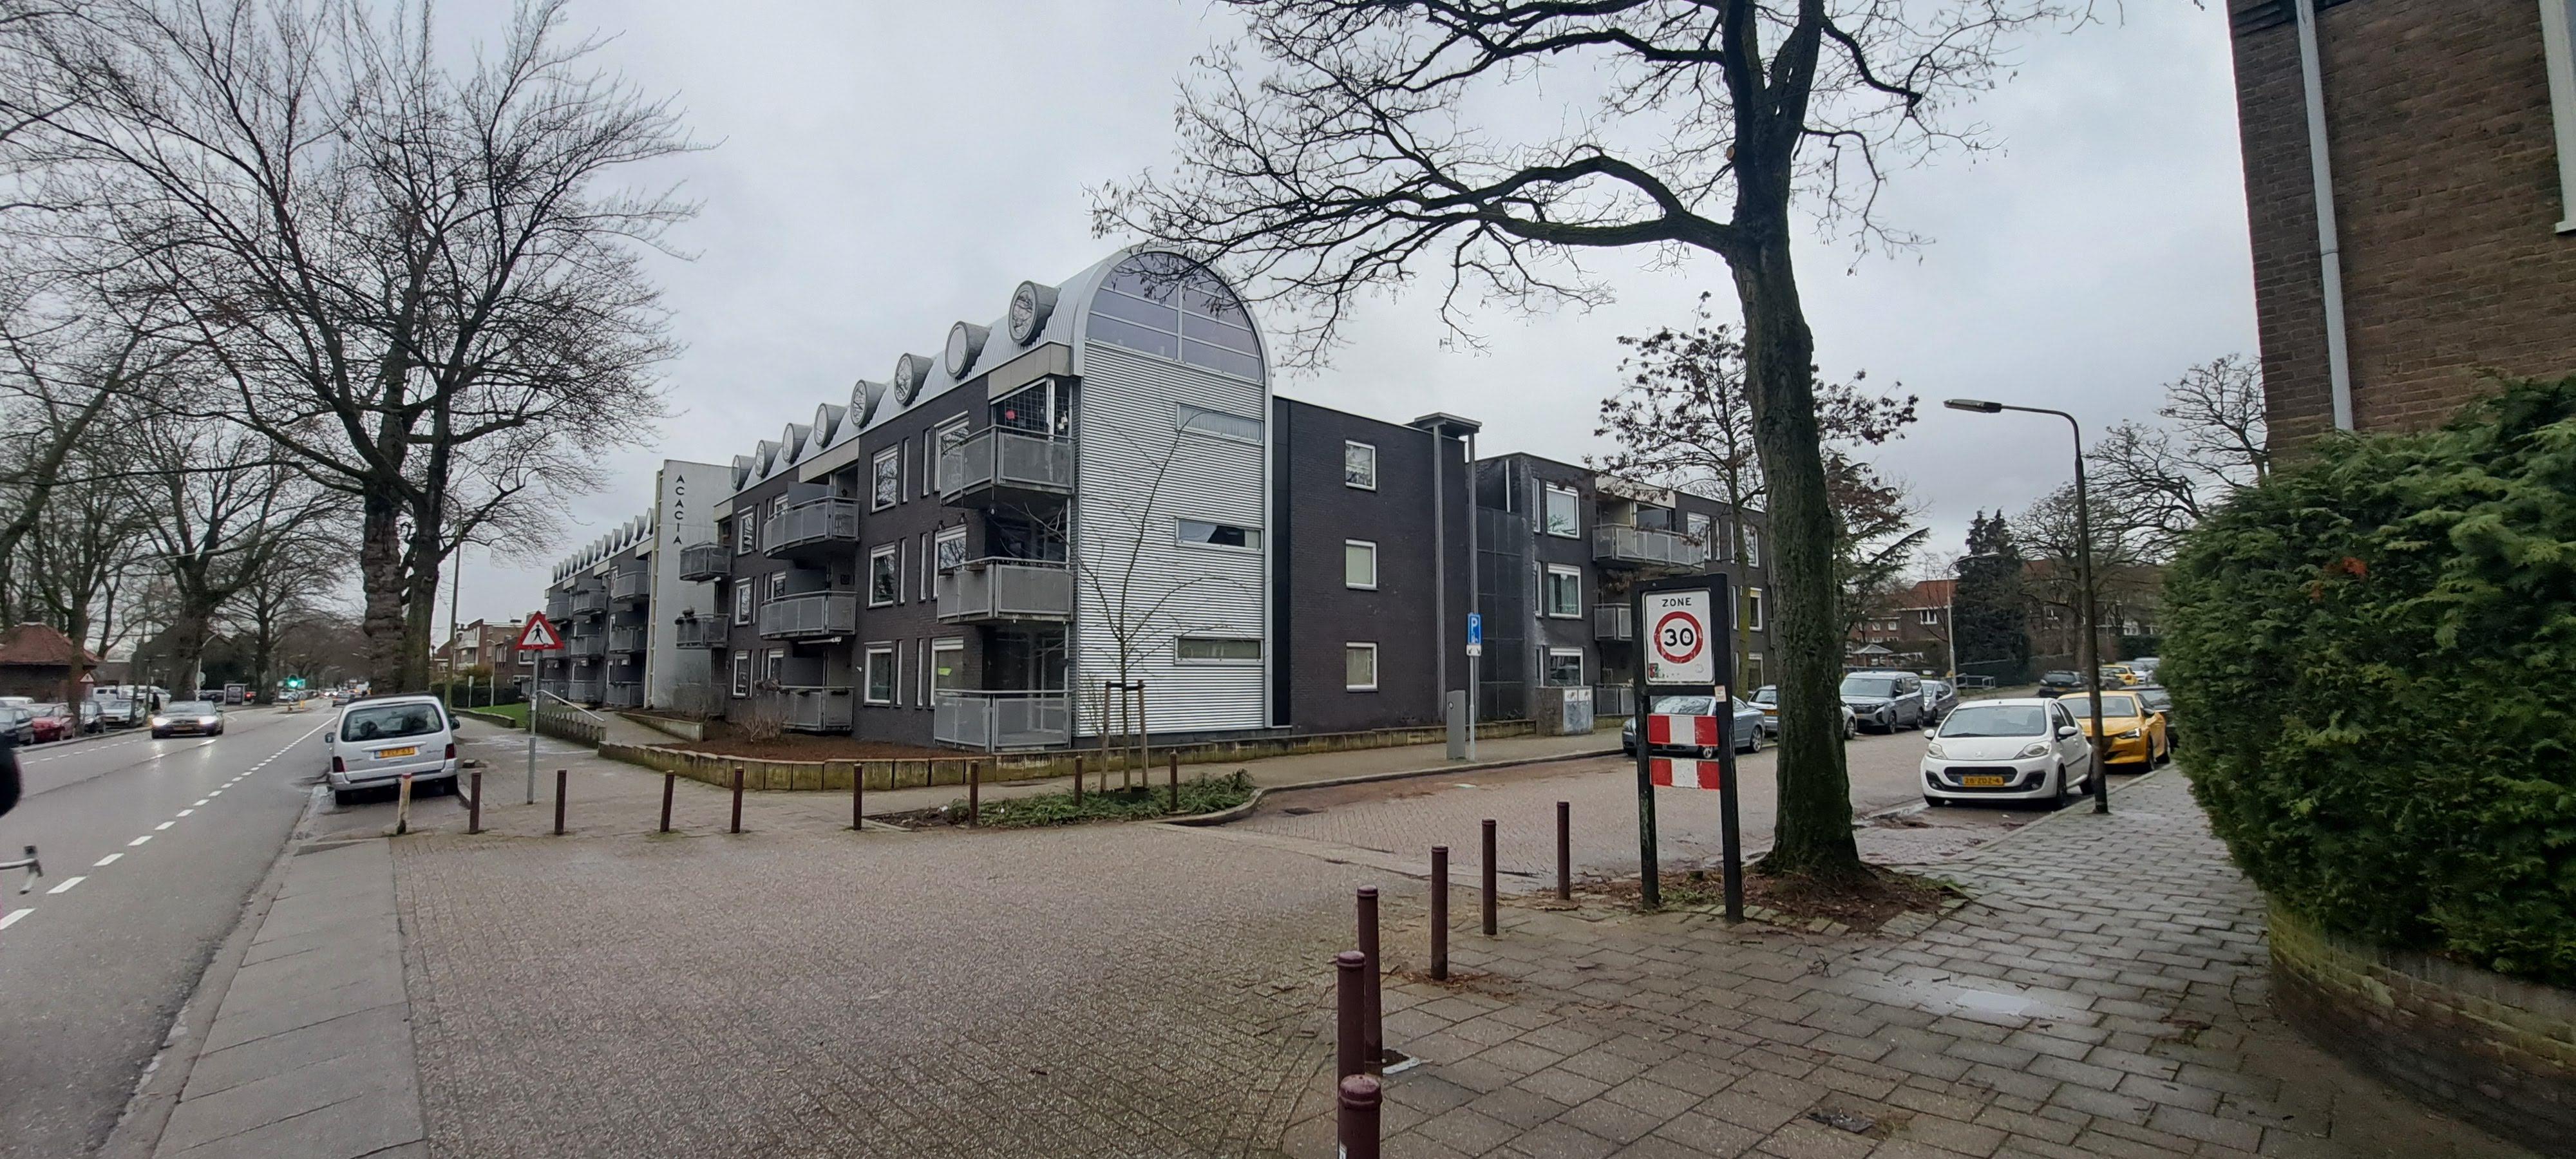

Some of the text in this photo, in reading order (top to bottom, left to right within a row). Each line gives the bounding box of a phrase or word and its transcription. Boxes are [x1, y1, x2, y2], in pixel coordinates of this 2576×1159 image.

[673, 475, 685, 545] ACACIA
[1662, 597, 1692, 607] ZONE
[1664, 627, 1694, 646] 30
